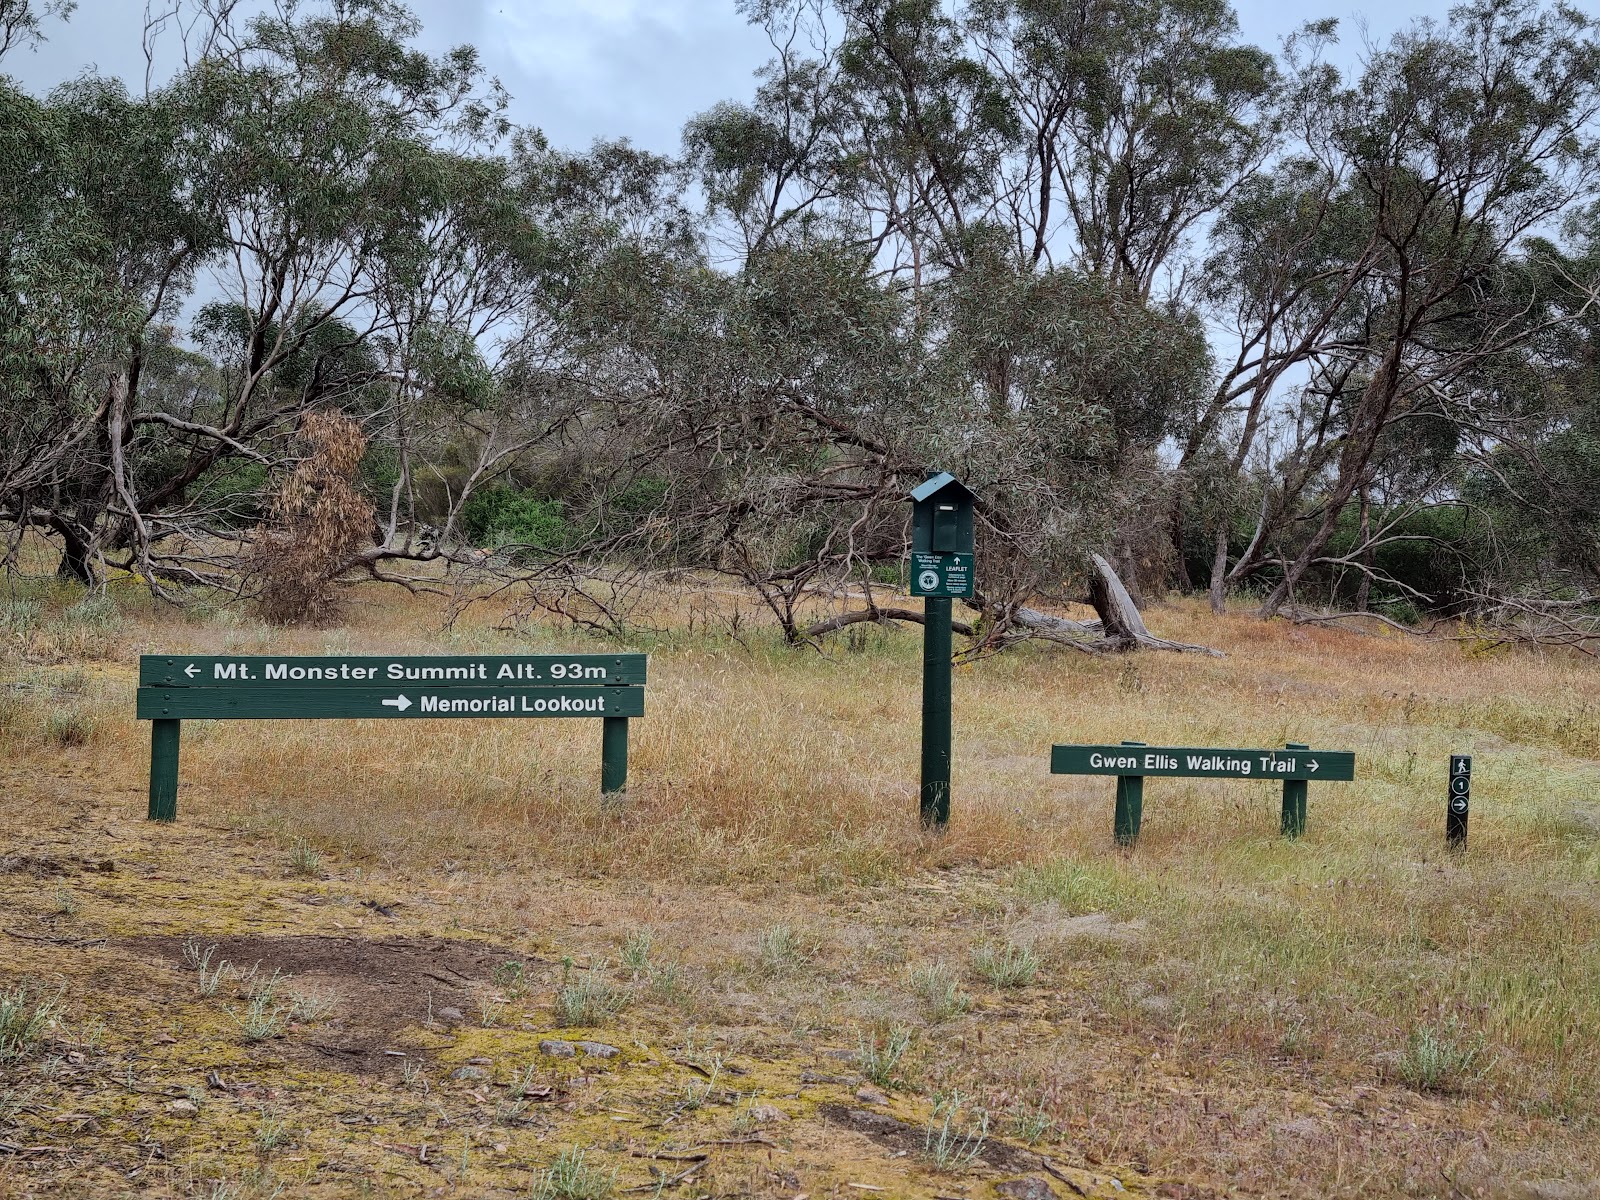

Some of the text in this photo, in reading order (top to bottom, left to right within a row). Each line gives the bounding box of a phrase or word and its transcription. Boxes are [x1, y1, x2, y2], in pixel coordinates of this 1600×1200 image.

[213, 662, 607, 680] Mt. Monster Summit Alt. 93m
[420, 695, 605, 713] Memorial Lookout
[1089, 752, 1296, 775] Gwen Ellis Walking Trail
